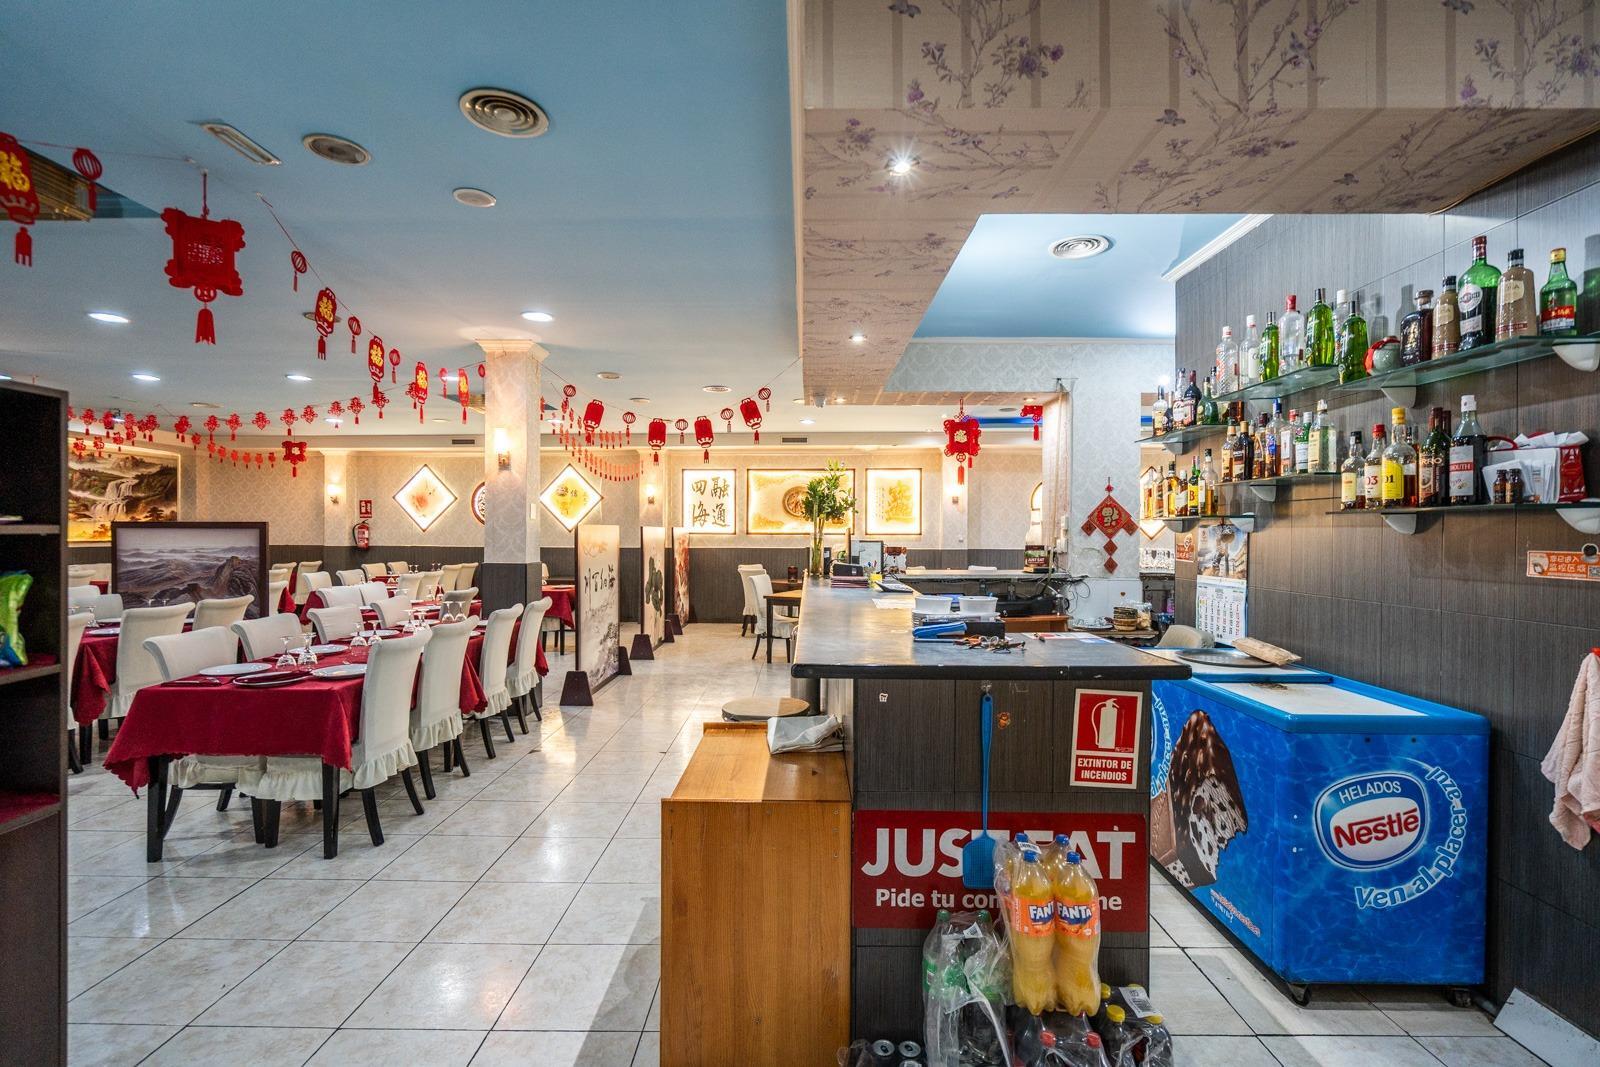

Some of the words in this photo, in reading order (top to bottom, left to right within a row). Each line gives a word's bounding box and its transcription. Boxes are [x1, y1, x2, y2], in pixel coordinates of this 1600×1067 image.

[1077, 757, 1119, 769] EXTINTOR
[1120, 760, 1132, 770] DE
[1081, 769, 1127, 781] INCENDIOS
[1338, 780, 1402, 804] HELADOS
[1424, 766, 1463, 802] azul
[1432, 805, 1468, 879] placer
[1411, 866, 1437, 895] al
[876, 888, 926, 907] Pide
[931, 889, 955, 908] tu
[1056, 901, 1093, 919] FANTA
[1354, 886, 1406, 910] Ven
